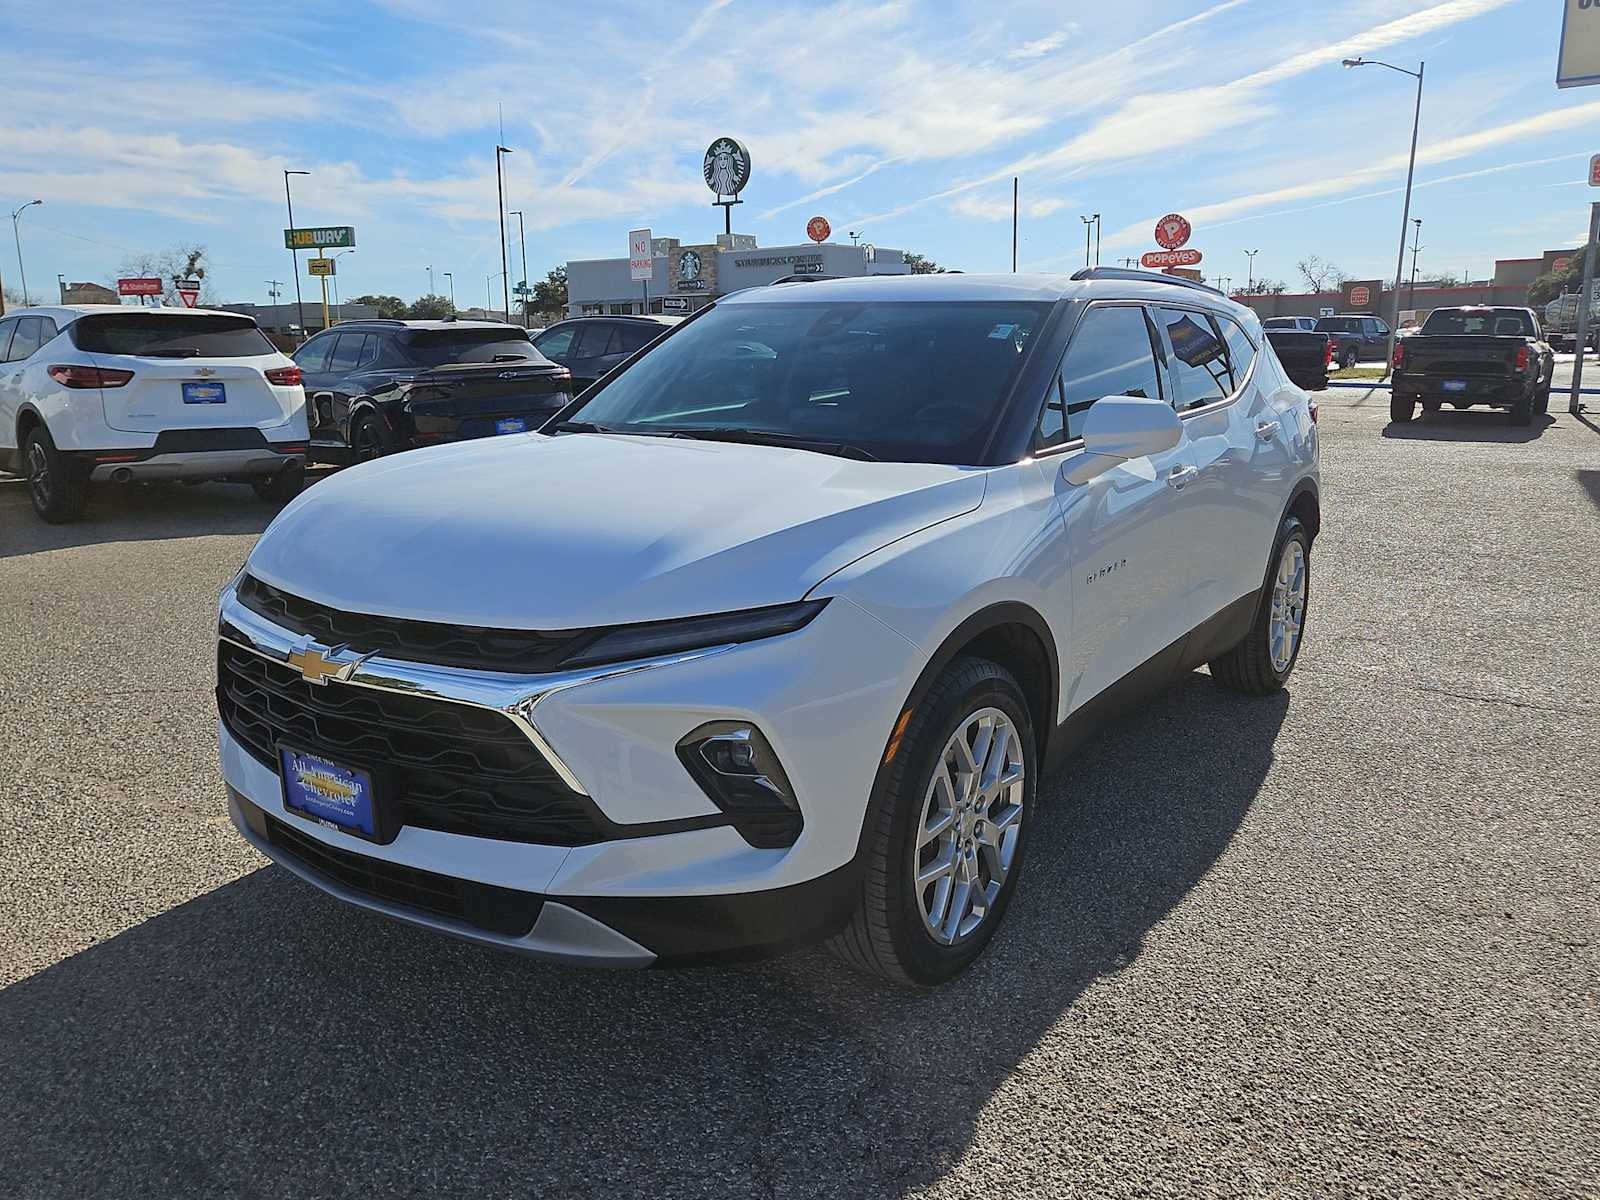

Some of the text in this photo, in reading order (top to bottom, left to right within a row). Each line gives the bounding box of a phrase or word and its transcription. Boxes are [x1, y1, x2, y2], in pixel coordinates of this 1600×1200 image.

[288, 230, 344, 246] SUBWAY
[634, 241, 646, 254] NO
[631, 258, 652, 270] PARKING
[291, 759, 363, 794] All American
